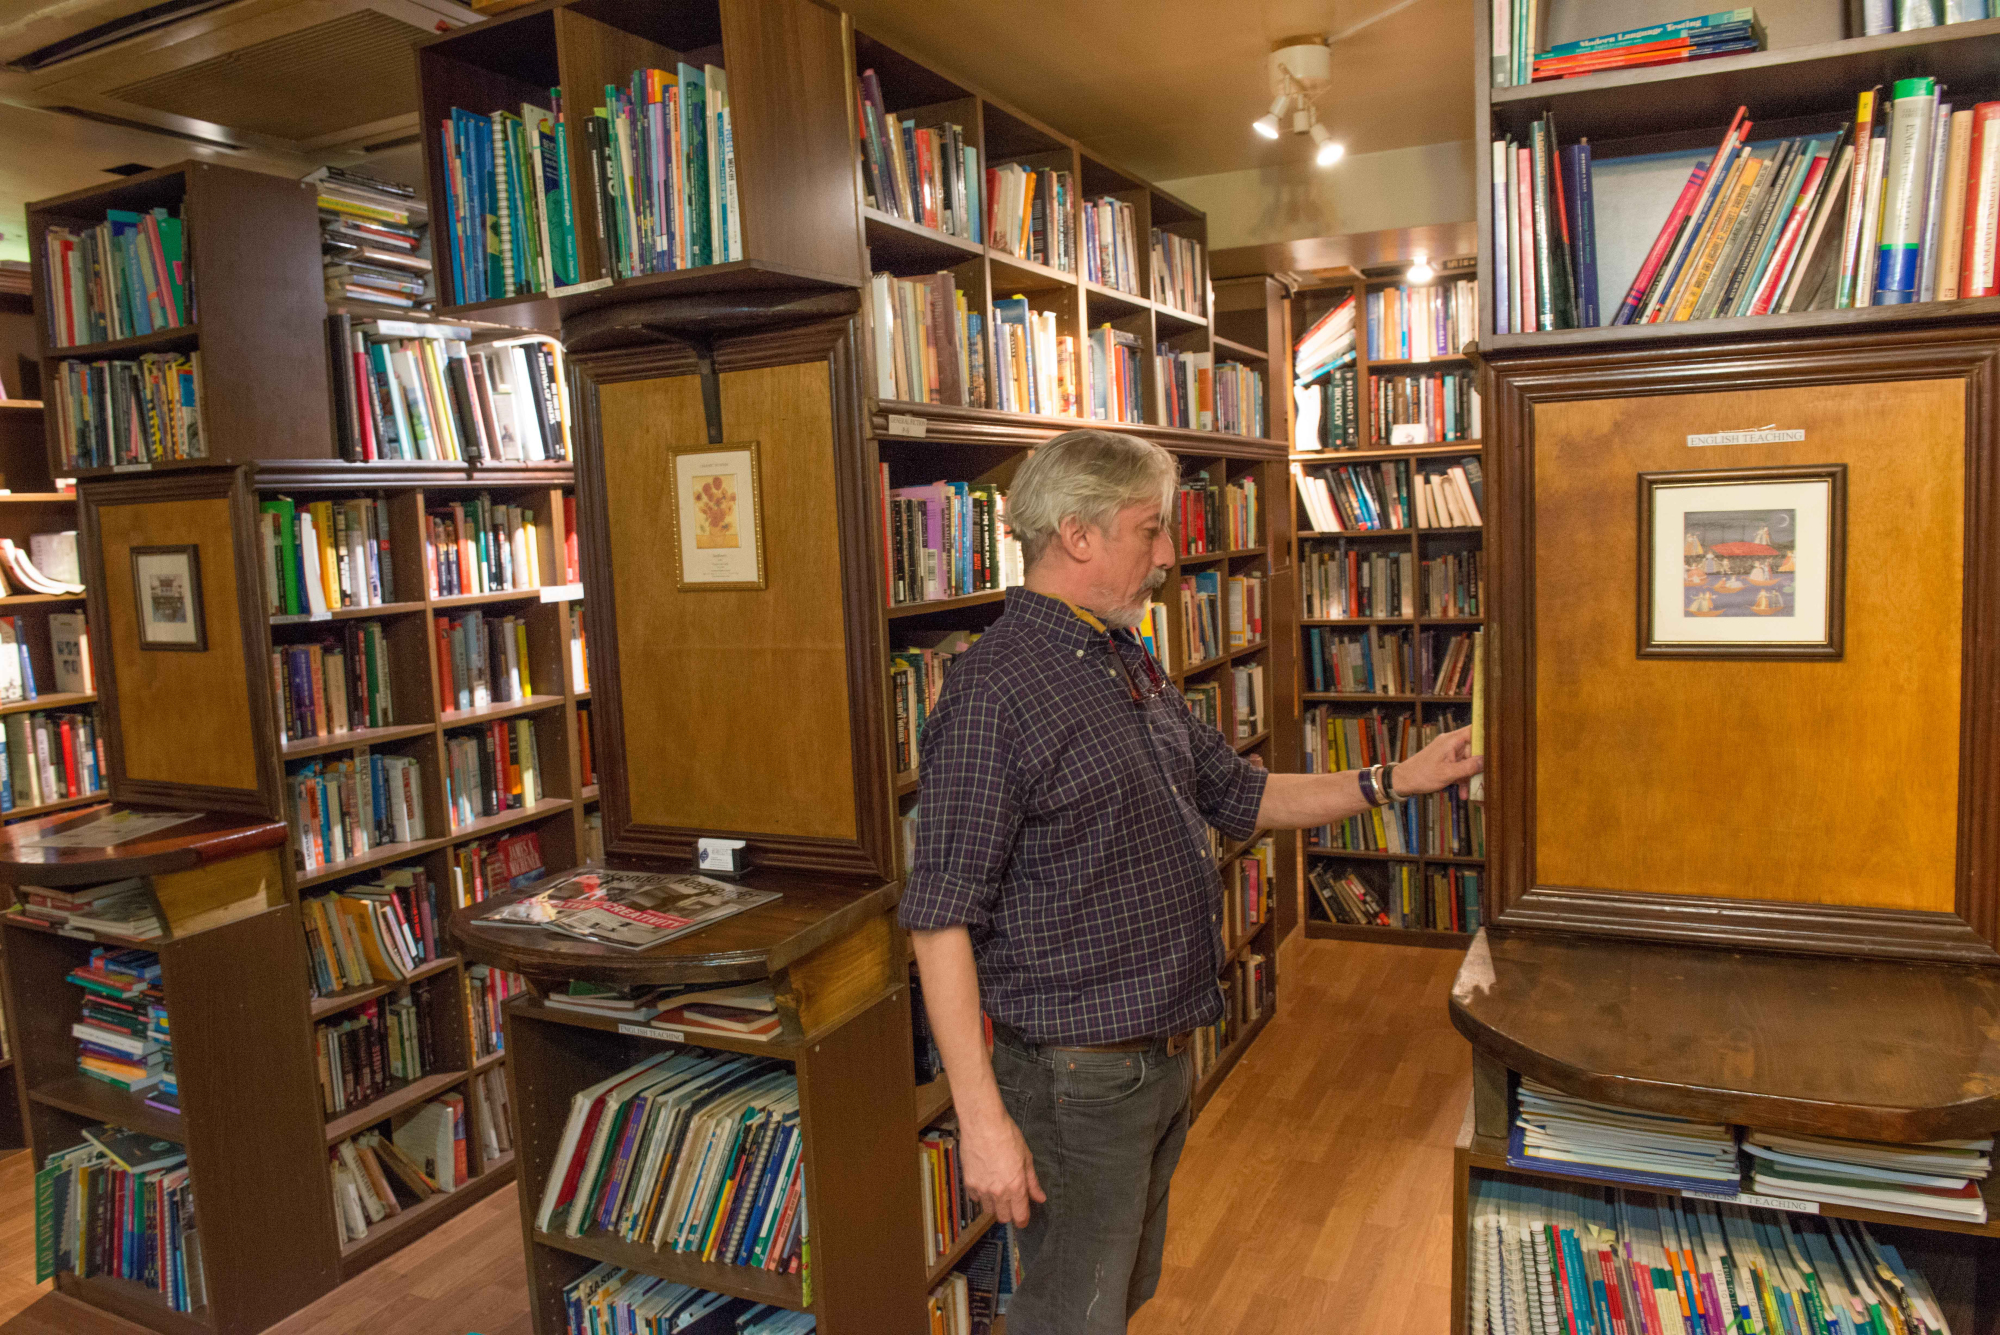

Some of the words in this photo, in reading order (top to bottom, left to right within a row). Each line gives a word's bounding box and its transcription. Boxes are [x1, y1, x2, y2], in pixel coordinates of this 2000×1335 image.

[1579, 36, 1613, 47] Modern
[1617, 26, 1662, 40] Language
[1666, 18, 1701, 31] Testing
[557, 131, 567, 173] Communicative
[1536, 131, 1545, 174] TARGETING
[561, 174, 569, 199] Grammar
[1333, 387, 1342, 425] BIOLOGY
[1690, 433, 1739, 446] ENGLISH
[1742, 430, 1803, 444] TEACHING
[603, 903, 686, 929] CREATIVITY
[619, 1024, 648, 1035] ENGLISH
[649, 1029, 683, 1040] TEACHING
[1748, 1196, 1807, 1210] TEACHING
[1716, 1269, 1724, 1285] TRUE
[1722, 1264, 1731, 1281] TRUE
[1675, 1275, 1685, 1297] Initiative
[1689, 1272, 1699, 1295] Initiative
[1727, 1284, 1734, 1294] TO
[1744, 1277, 1753, 1294] TRUE
[1720, 1289, 1727, 1298] TO
[1723, 1301, 1731, 1316] LIFE
[1730, 1297, 1738, 1311] LIFE
[1749, 1297, 1757, 1307] TO
[1752, 1309, 1761, 1324] LIFE
